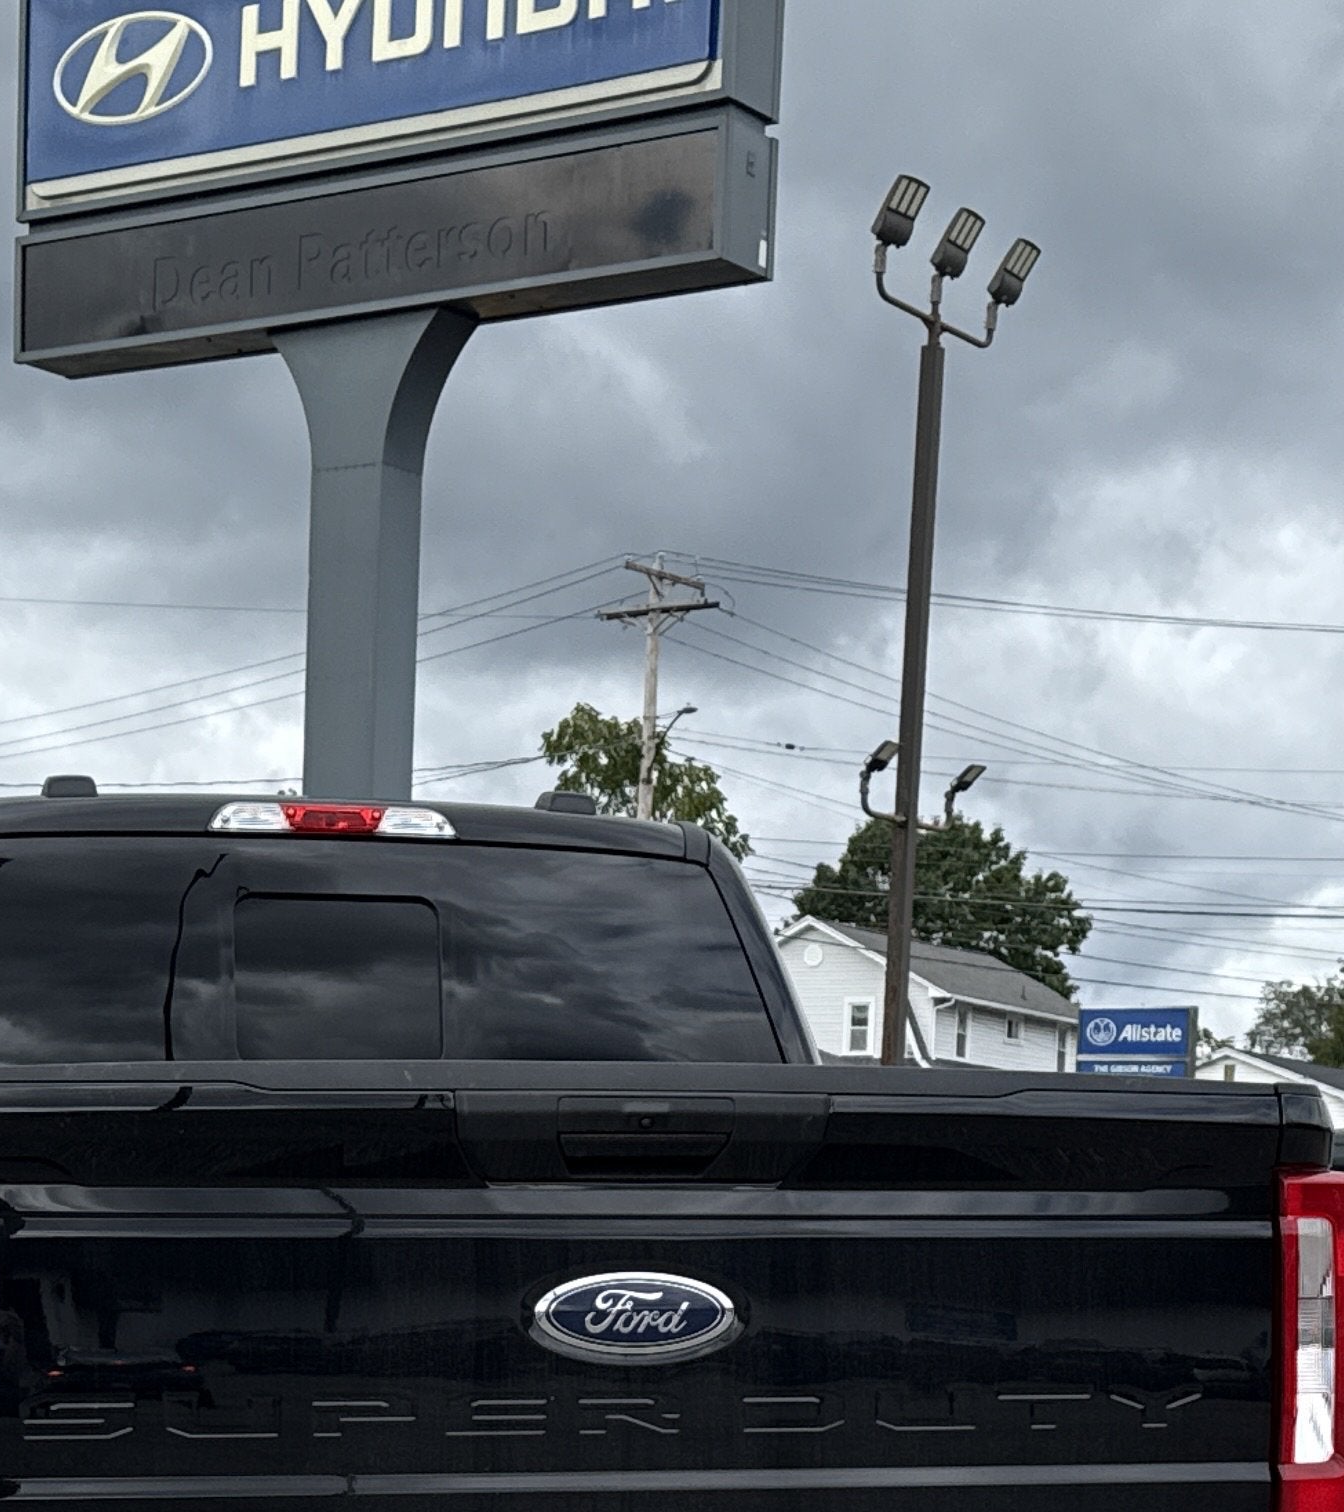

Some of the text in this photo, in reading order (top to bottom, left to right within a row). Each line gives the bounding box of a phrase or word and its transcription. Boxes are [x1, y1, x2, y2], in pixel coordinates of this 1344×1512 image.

[239, 0, 682, 88] HYUN
[151, 208, 551, 313] Dean Patterson
[1118, 1023, 1183, 1042] Allstate
[584, 1289, 690, 1334] Ford
[22, 1391, 1204, 1440] SUPER DUTY
